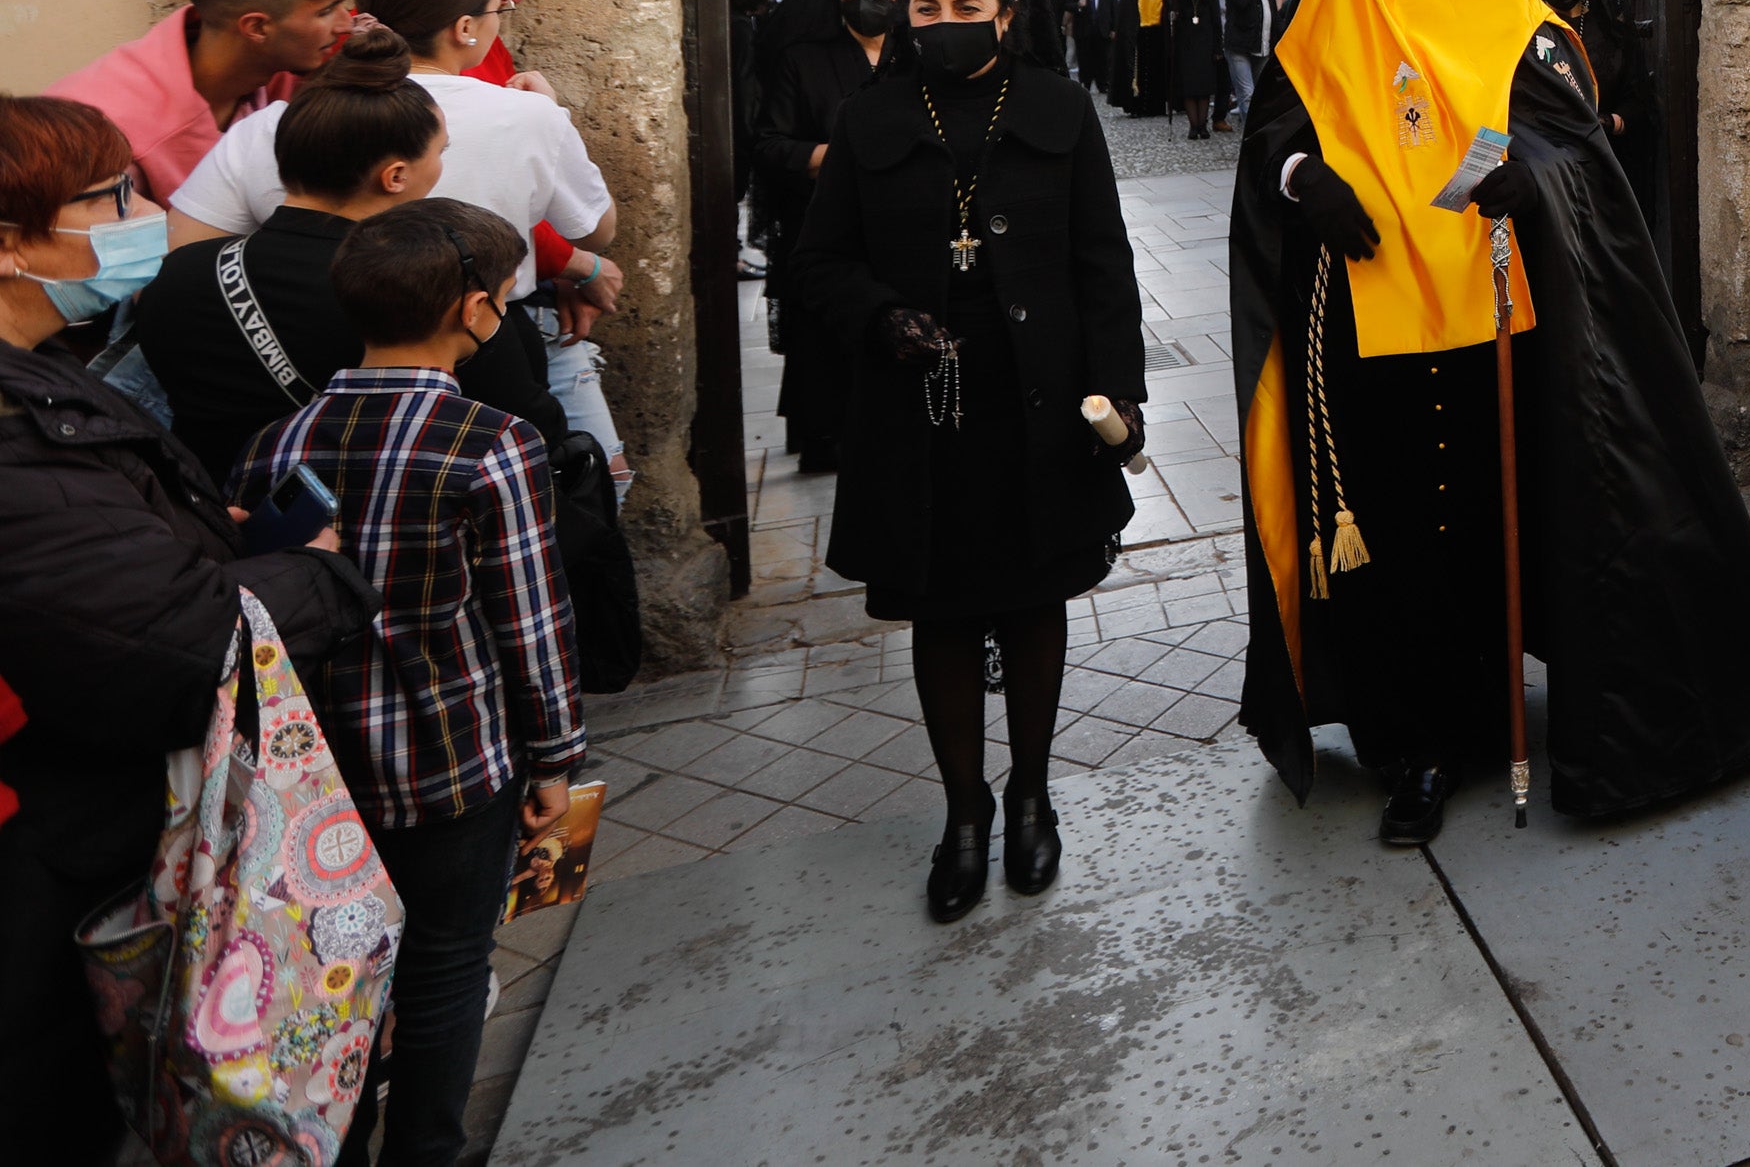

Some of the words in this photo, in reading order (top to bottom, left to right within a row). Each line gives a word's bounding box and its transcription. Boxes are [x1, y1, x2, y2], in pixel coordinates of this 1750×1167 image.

[220, 238, 247, 299] LOLA
[232, 298, 254, 320] Y
[244, 310, 298, 386] BIMBA
